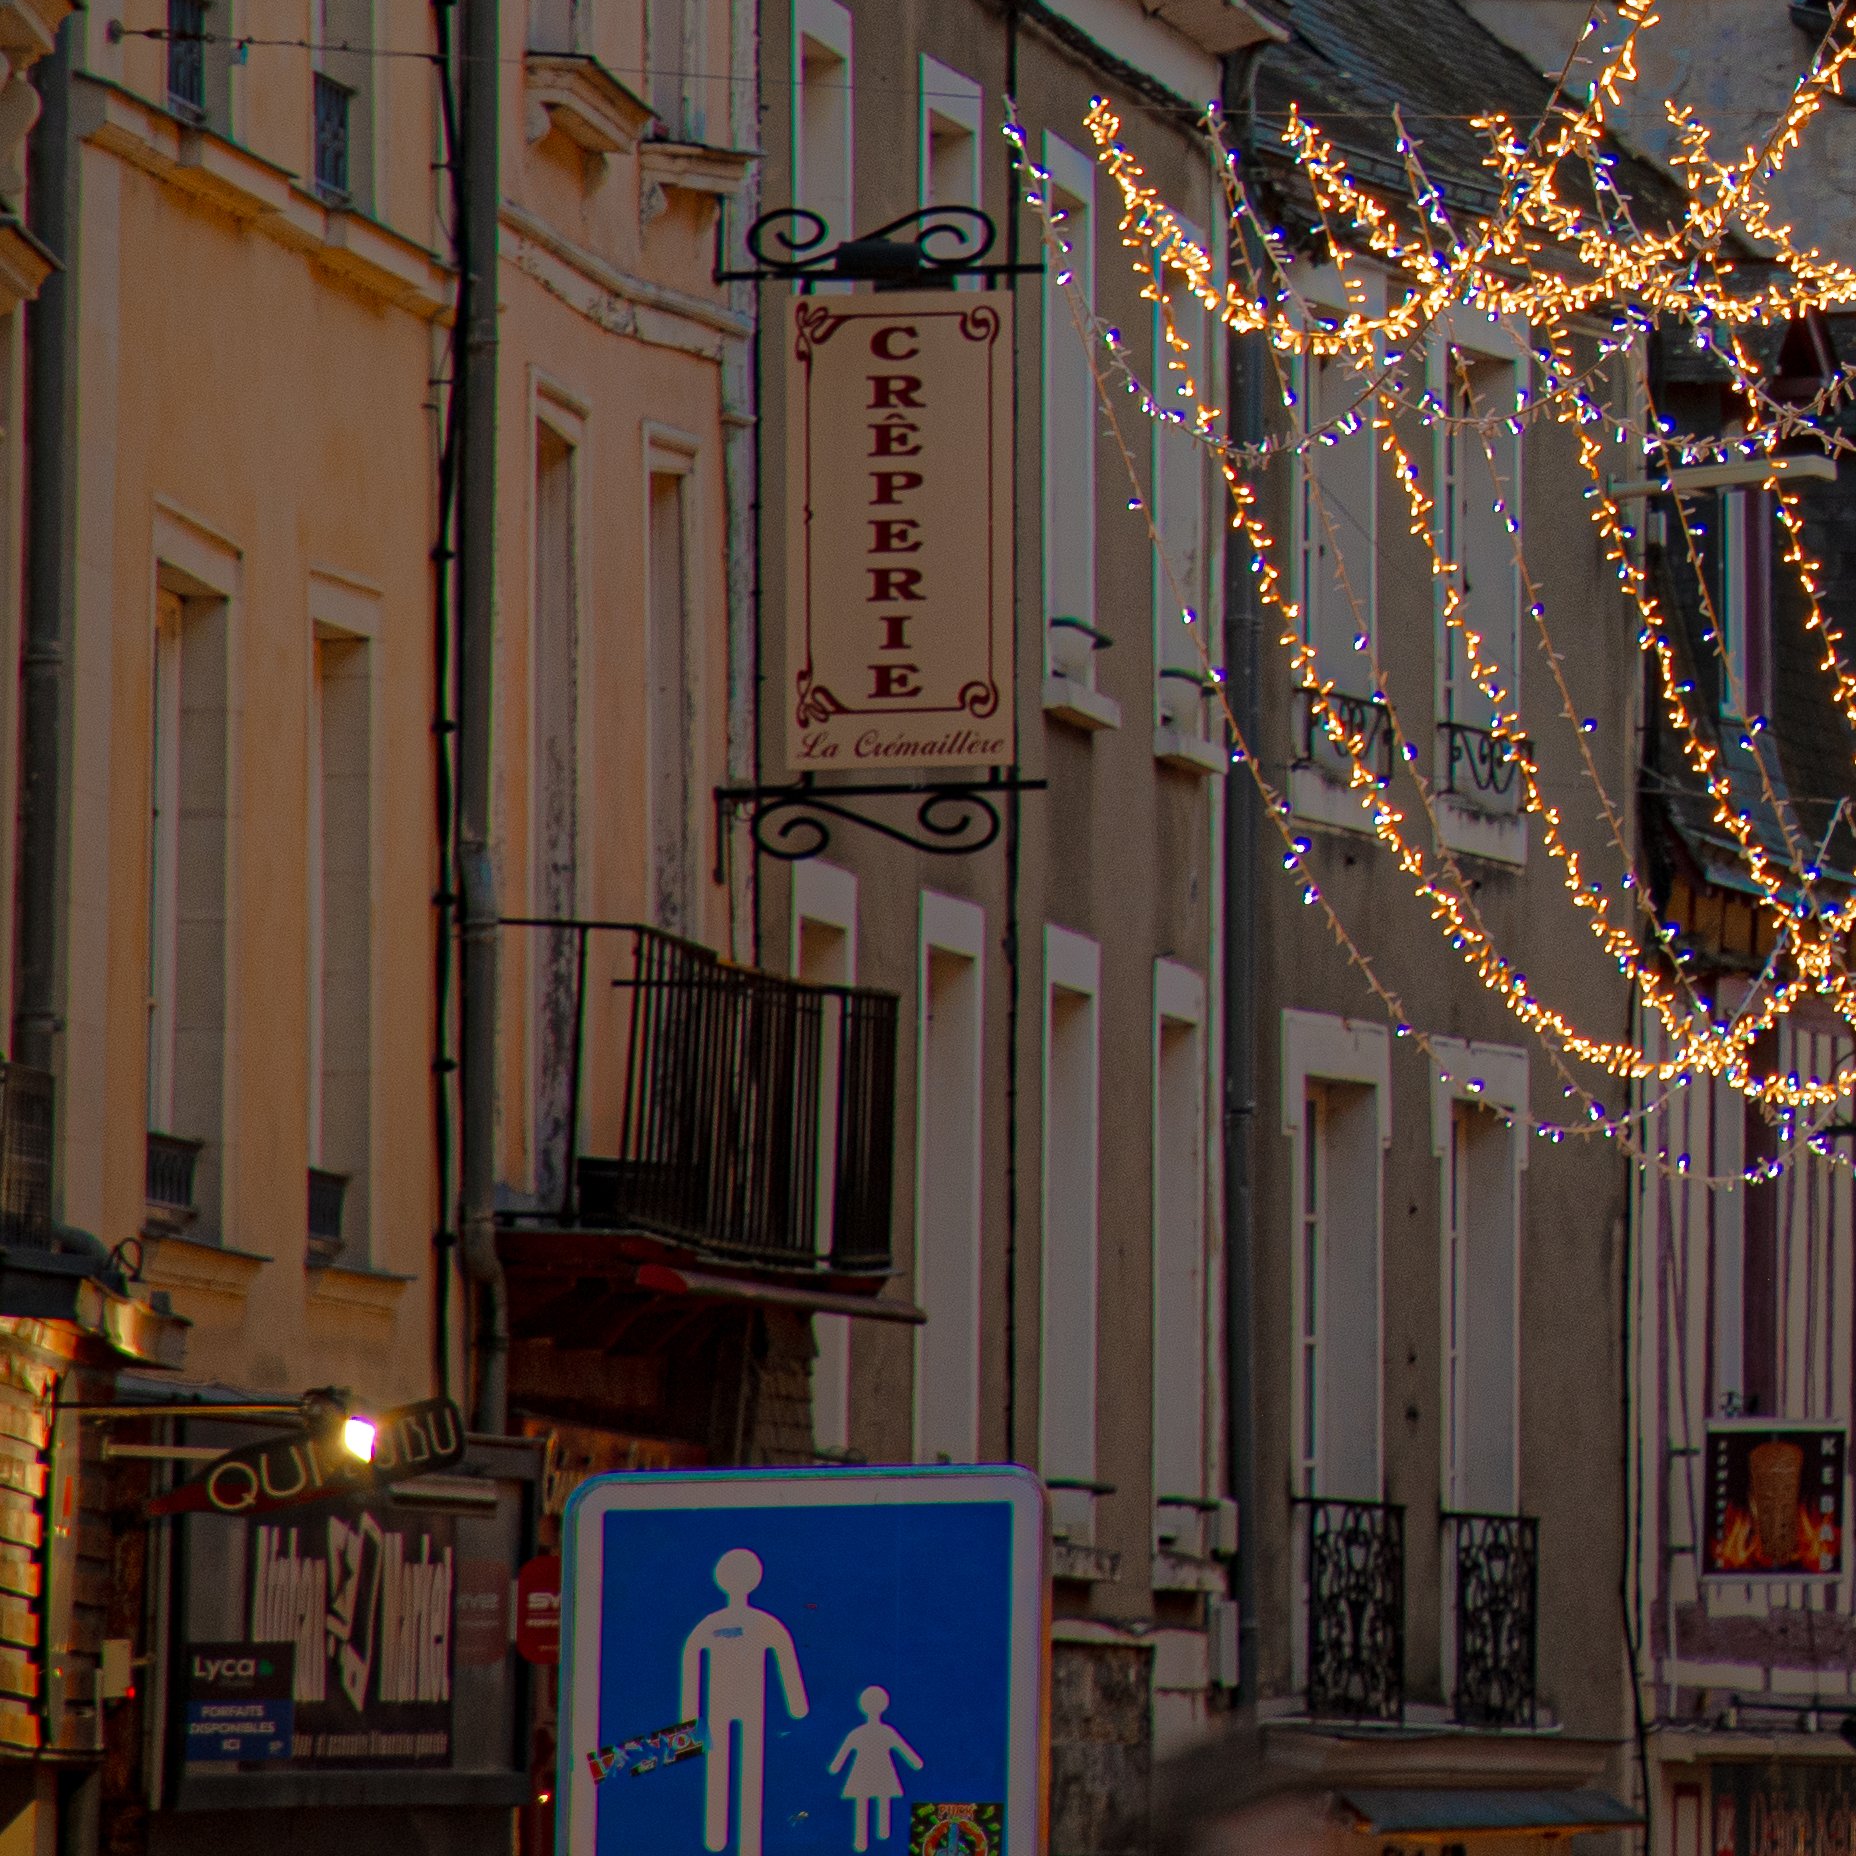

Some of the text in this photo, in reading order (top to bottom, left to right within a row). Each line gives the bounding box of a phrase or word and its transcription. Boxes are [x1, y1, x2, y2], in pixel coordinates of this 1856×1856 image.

[866, 325, 927, 698] CRÊPERIE
[798, 728, 1005, 759] La Crémaillère
[192, 1656, 257, 1681] Lyca
